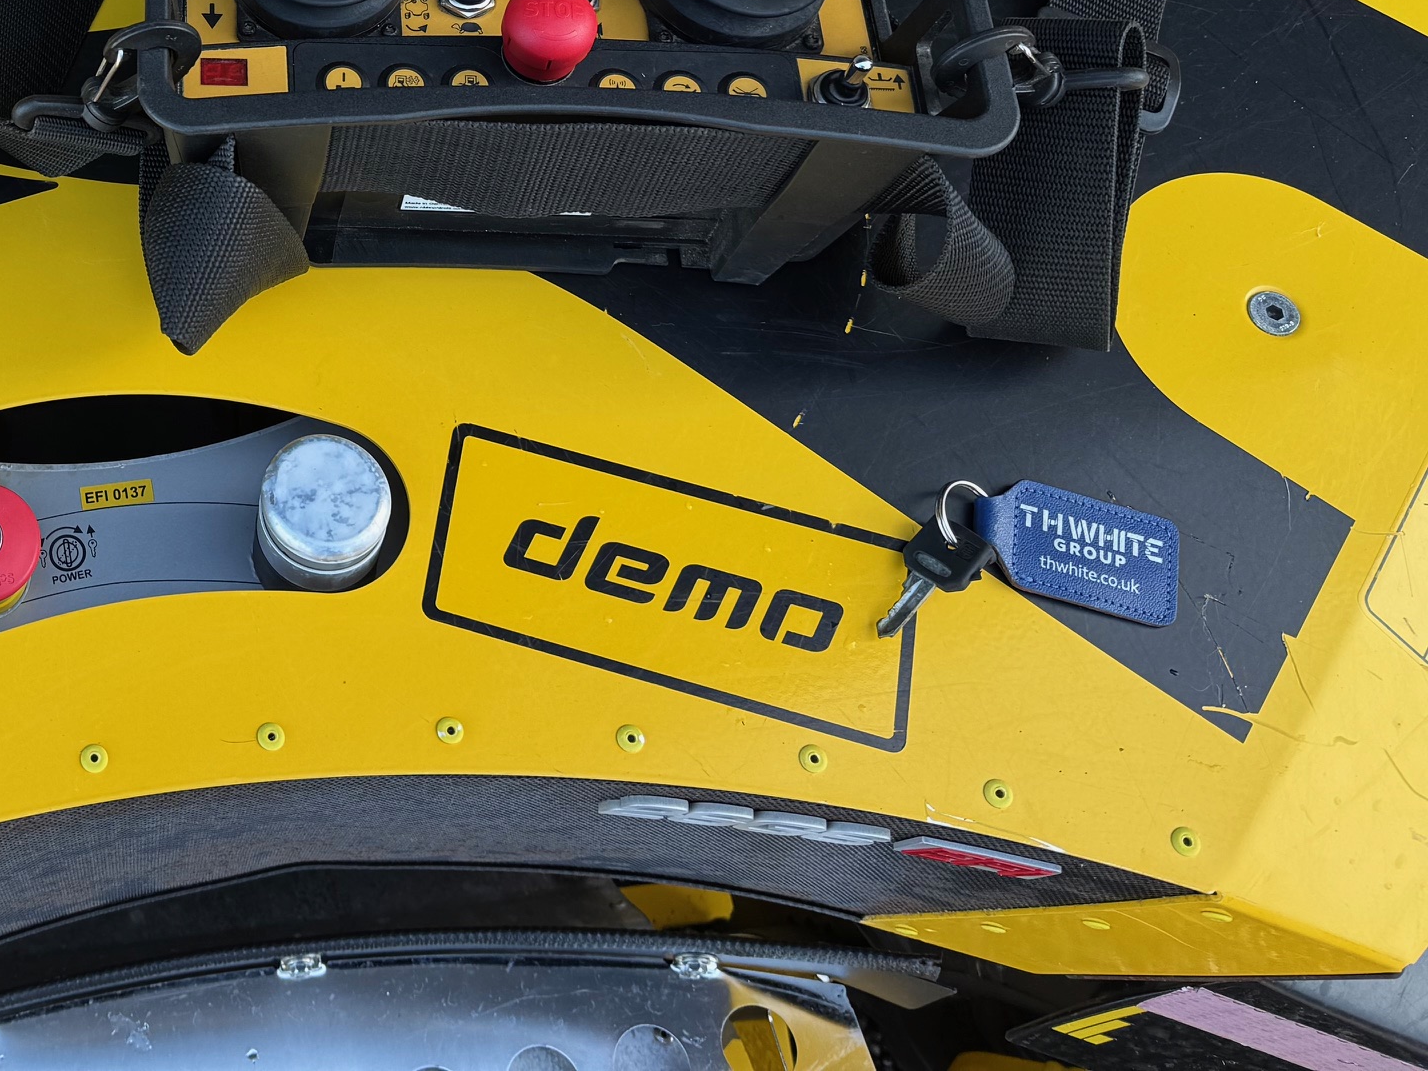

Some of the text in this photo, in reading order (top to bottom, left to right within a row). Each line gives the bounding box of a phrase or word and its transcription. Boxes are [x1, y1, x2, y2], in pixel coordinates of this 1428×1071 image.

[524, 1, 584, 18] STOP
[85, 485, 147, 504] EFI 0137
[1054, 537, 1127, 568] GROUP
[52, 569, 93, 584] POWER
[502, 515, 844, 652] demo
[1039, 555, 1140, 595] thwhite.co.uk
